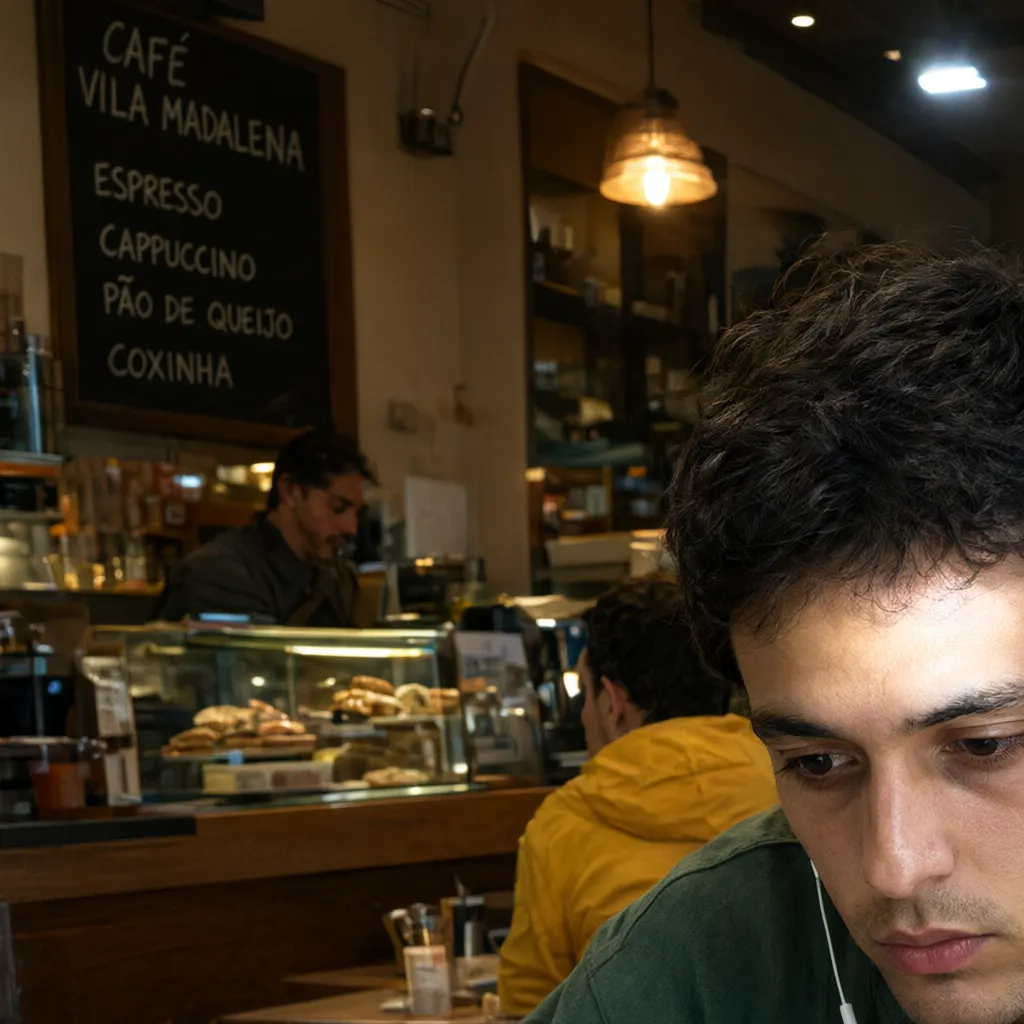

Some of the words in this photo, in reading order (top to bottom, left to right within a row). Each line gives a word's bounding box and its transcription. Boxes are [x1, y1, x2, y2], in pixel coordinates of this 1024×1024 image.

[103, 21, 188, 86] CAFÉ
[78, 66, 149, 126] VILA
[162, 95, 305, 171] MADALENA
[94, 162, 221, 219] ESPRESSO
[100, 224, 256, 281] CAPPUCCINO
[103, 275, 153, 318] PÃO
[165, 295, 194, 324] DE
[207, 301, 292, 339] QUEIJO
[107, 343, 233, 389] COXINHA
